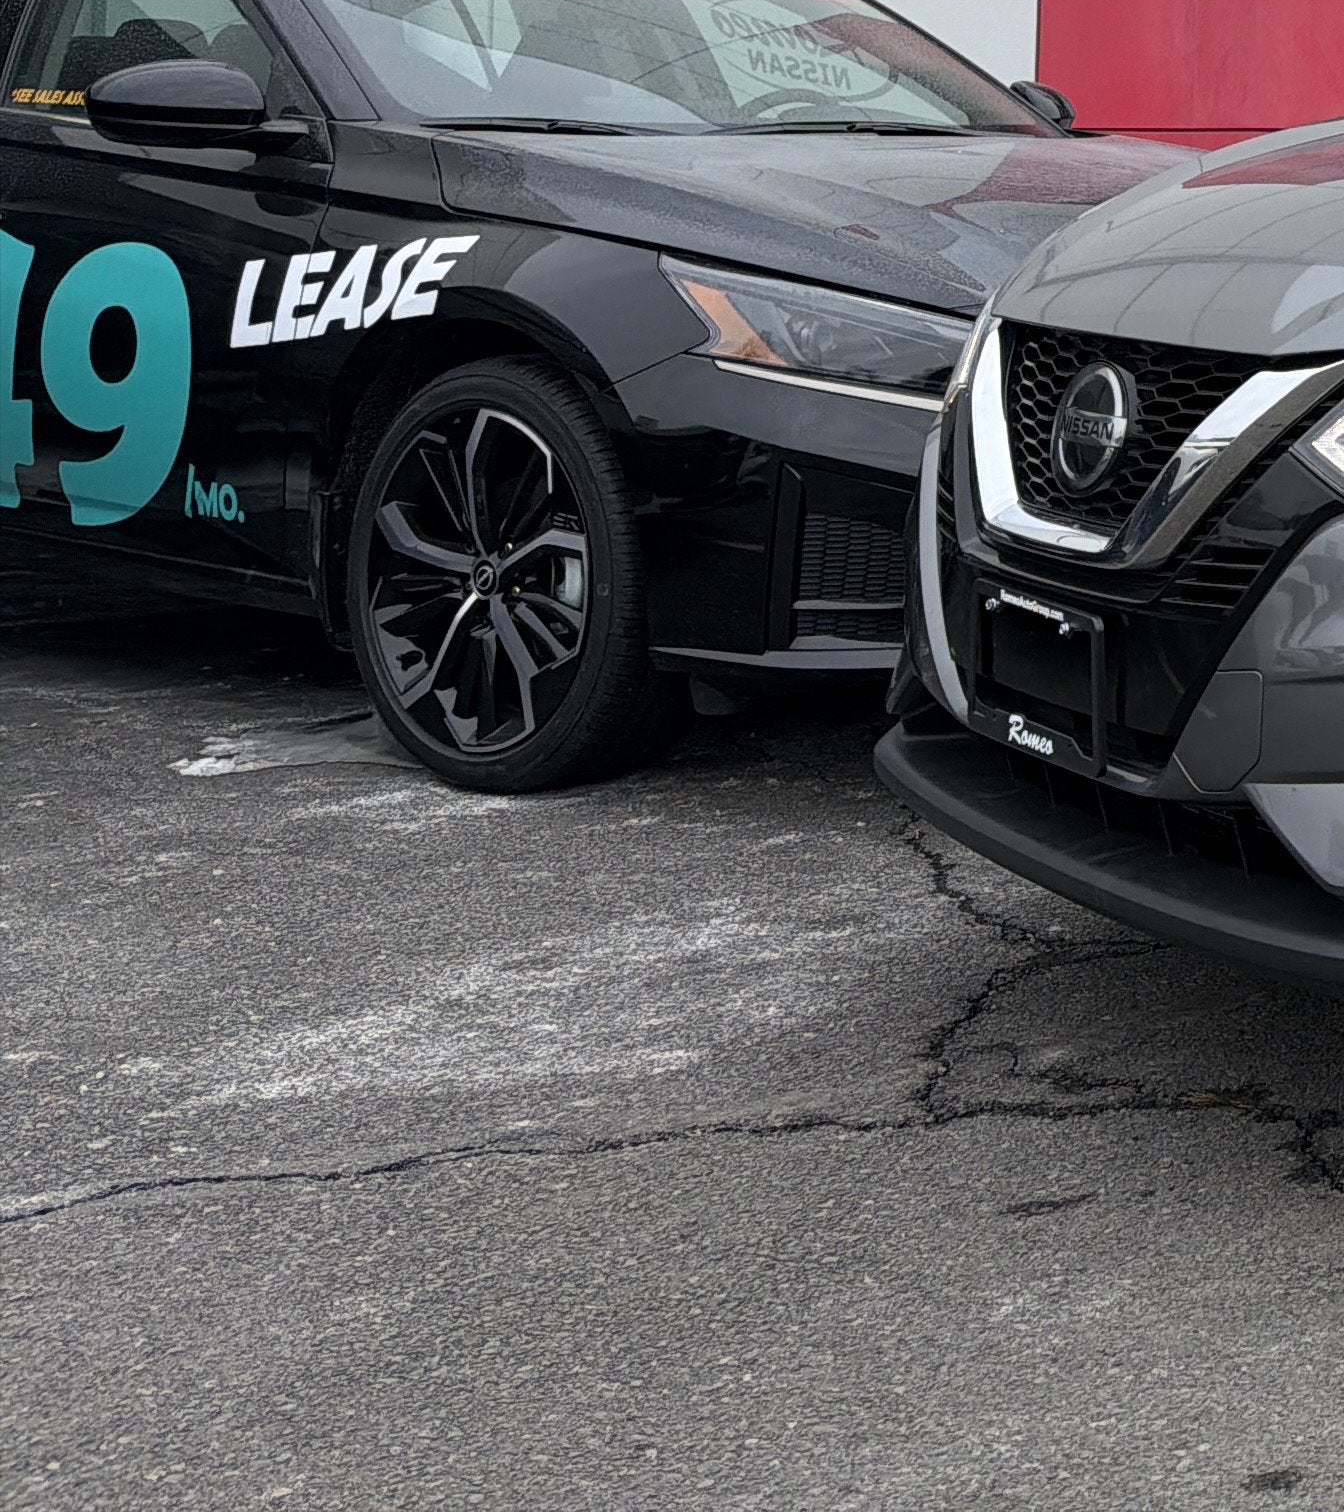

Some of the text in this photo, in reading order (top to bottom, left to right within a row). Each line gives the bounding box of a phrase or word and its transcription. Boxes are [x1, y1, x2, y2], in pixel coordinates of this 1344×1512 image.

[32, 90, 66, 105] SALES
[230, 235, 480, 348] LEASE
[1061, 413, 1115, 440] NISSAN
[184, 463, 245, 523] /MO.
[1008, 714, 1054, 755] Romeo
